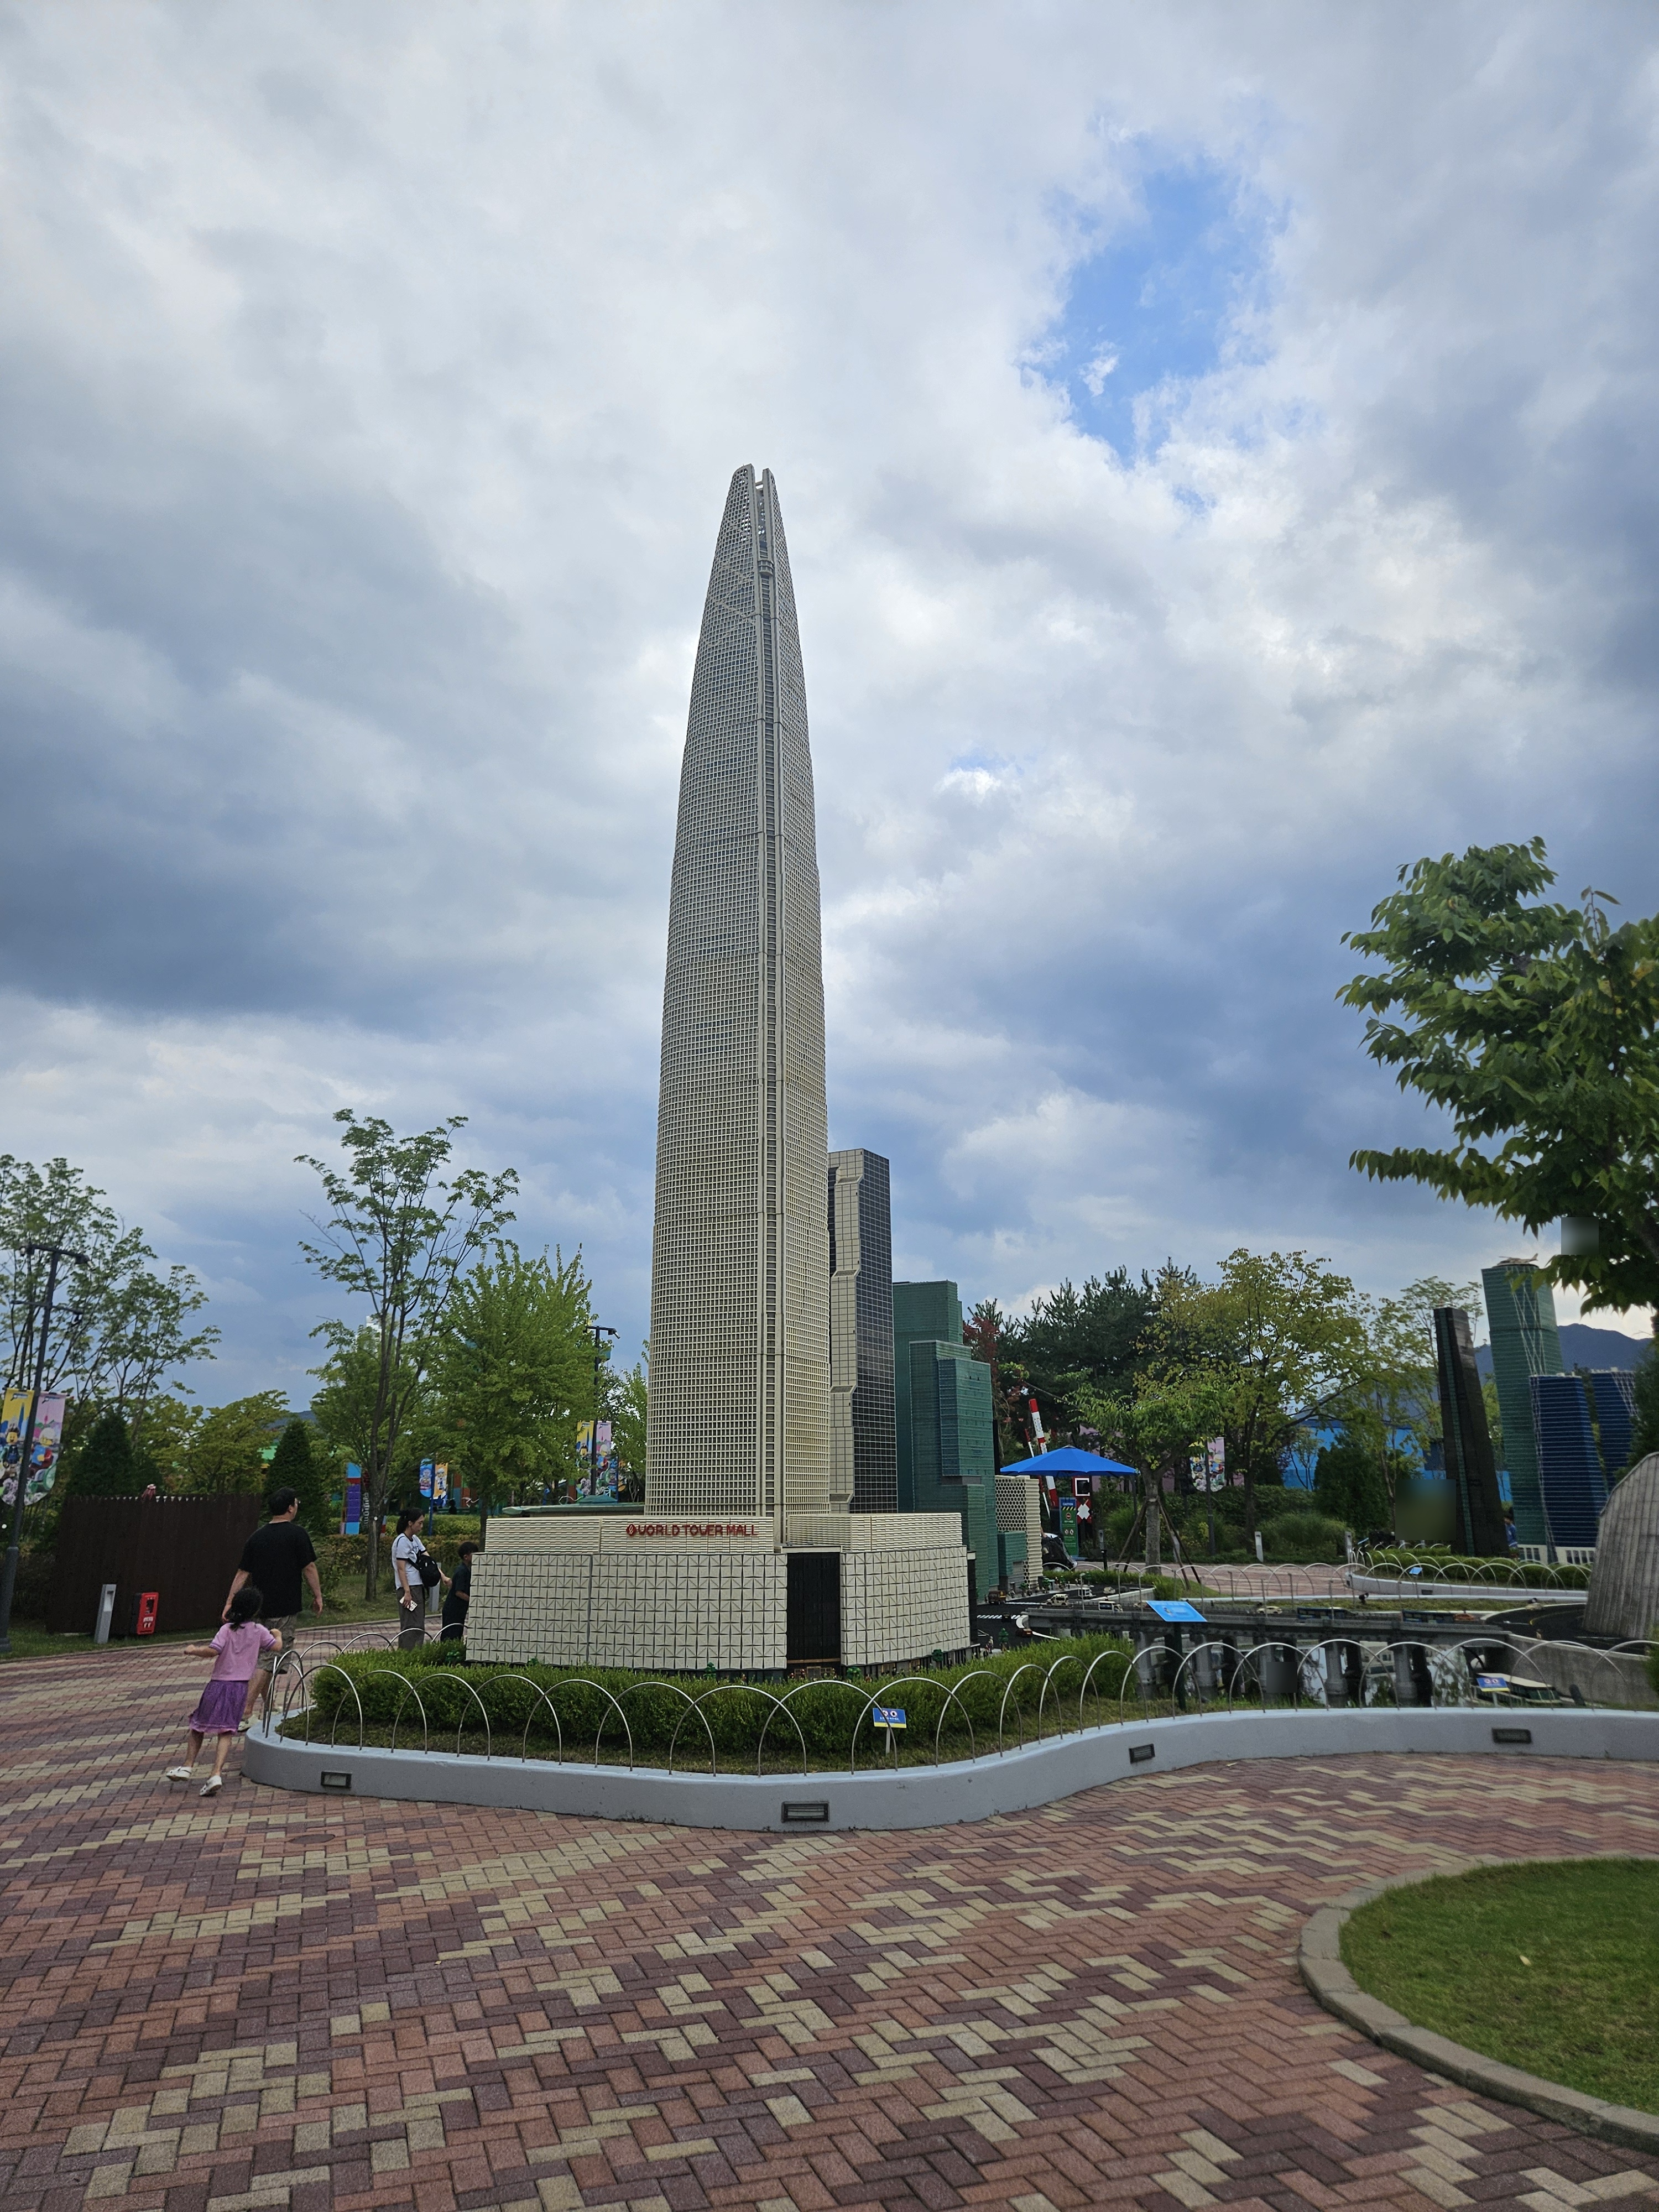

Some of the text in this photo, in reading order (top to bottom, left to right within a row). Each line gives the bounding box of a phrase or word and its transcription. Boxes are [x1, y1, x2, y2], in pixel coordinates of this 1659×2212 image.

[638, 1525, 759, 1536] WORLD TOWER MALL
